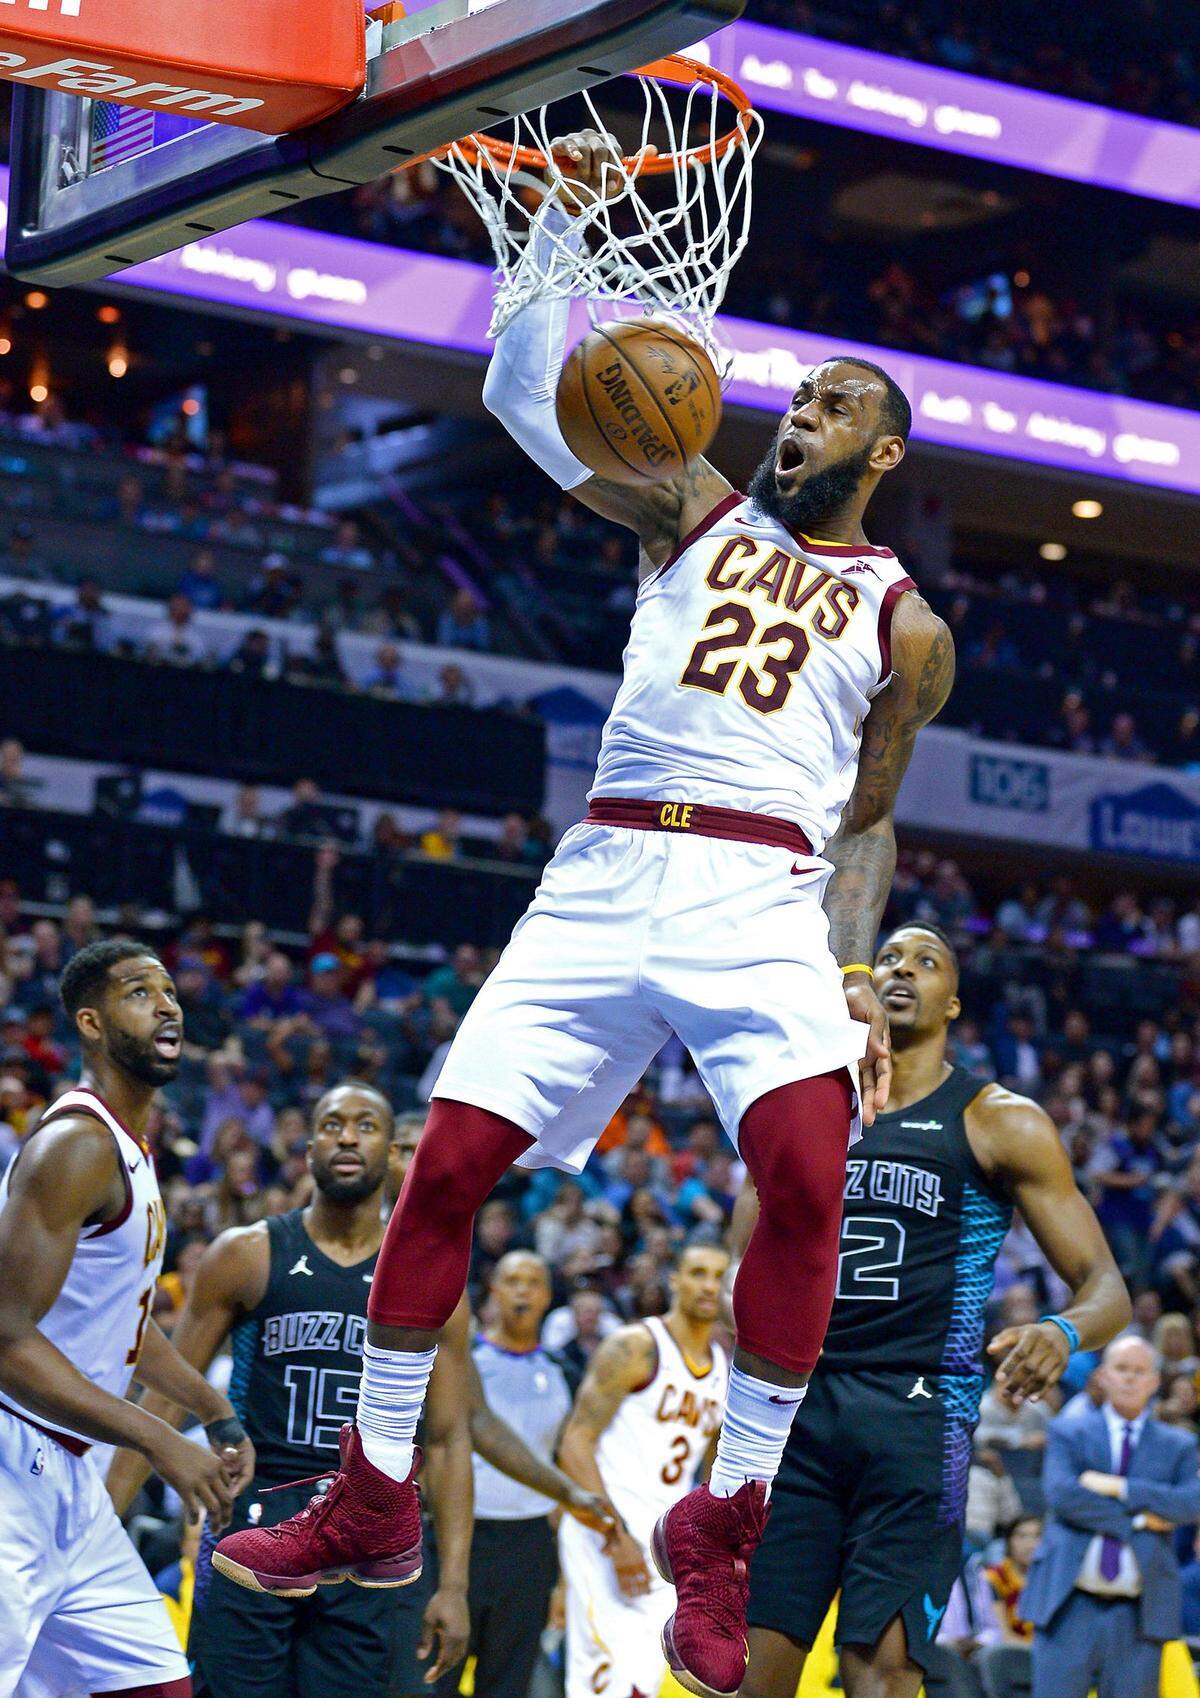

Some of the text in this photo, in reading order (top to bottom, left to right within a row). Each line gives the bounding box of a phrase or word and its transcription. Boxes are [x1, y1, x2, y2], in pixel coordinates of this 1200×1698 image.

[9, 58, 265, 115] Farm
[596, 361, 677, 467] SPALDING
[704, 533, 861, 642] CAVS
[678, 601, 811, 716] 23
[660, 803, 694, 828] CLE
[869, 1160, 945, 1218] CITY
[262, 1311, 345, 1356] BUZZ
[661, 1435, 690, 1485] 3
